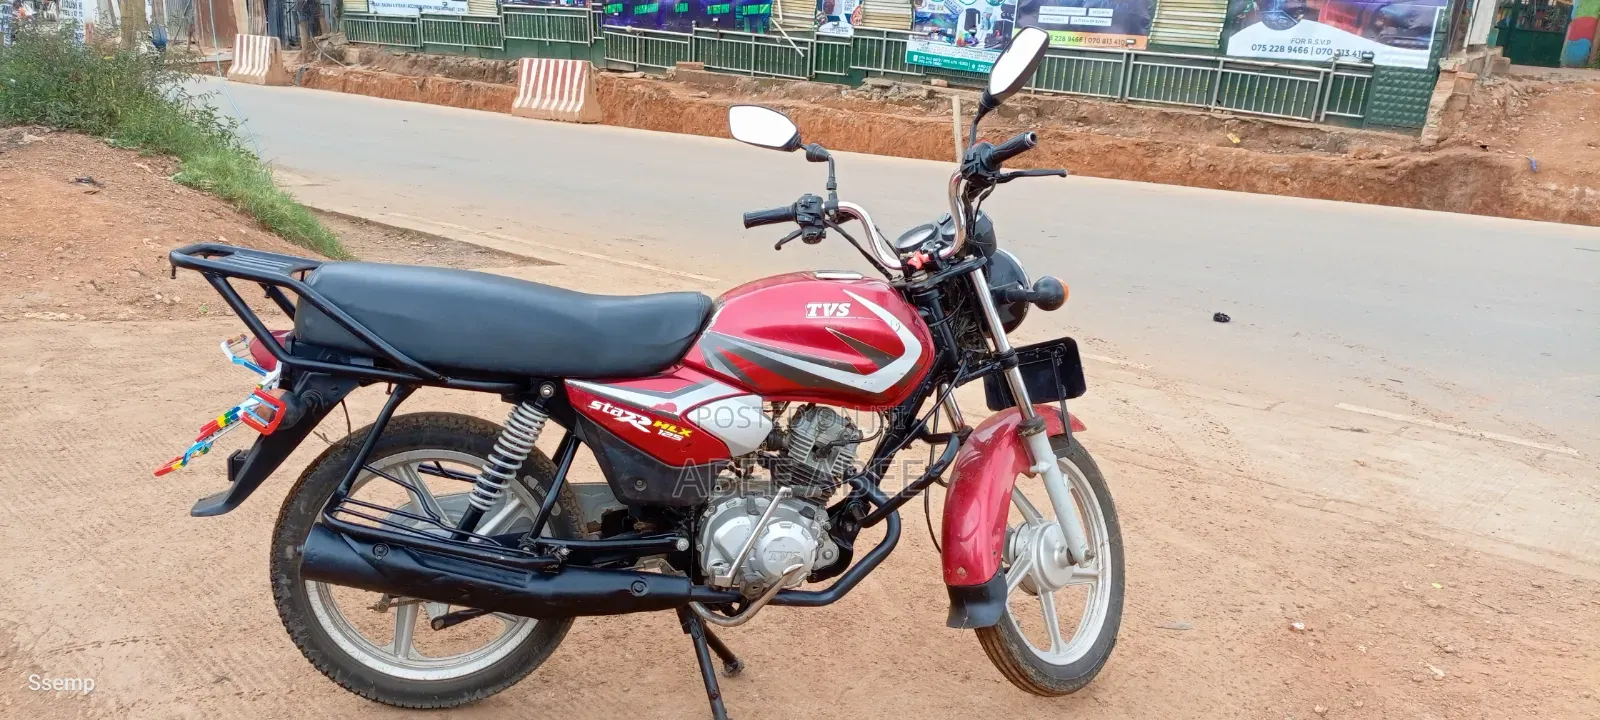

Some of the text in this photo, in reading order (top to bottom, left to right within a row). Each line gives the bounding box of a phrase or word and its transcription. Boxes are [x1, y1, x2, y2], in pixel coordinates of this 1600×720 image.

[1251, 44, 1267, 52] 075
[1287, 46, 1309, 54] 9466
[1316, 47, 1333, 55] 070
[806, 302, 851, 318] TVS
[653, 420, 692, 437] HLX
[658, 429, 684, 441] 125
[768, 550, 801, 562] TVS
